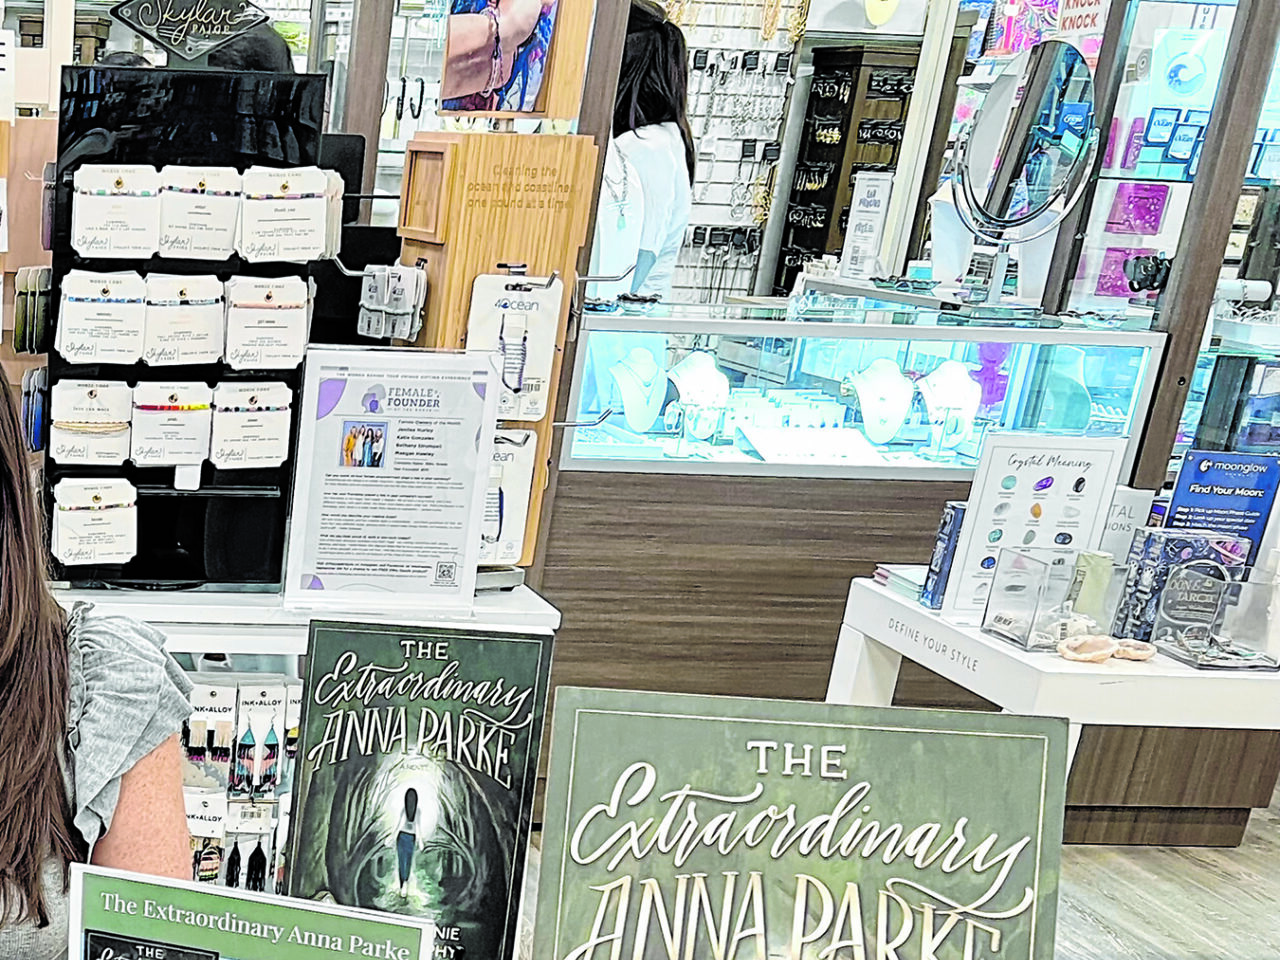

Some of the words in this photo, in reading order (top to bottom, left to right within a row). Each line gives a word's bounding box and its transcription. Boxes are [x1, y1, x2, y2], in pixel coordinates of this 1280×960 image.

[1061, 13, 1098, 31] KNOCK
[542, 166, 556, 176] the
[388, 388, 433, 398] FEMALE
[388, 398, 440, 408] FOUNDER
[1008, 453, 1044, 471] Crystal
[1046, 455, 1093, 472] Meaning
[1214, 462, 1268, 474] moonglow
[1190, 484, 1211, 494] Find
[1212, 486, 1234, 495] Your
[400, 639, 450, 661] THE
[888, 618, 920, 642] DEFINE
[923, 636, 948, 656] YOUR
[950, 649, 978, 672] STYLE
[313, 651, 534, 731] Extraordinary
[307, 705, 408, 772] ANNA
[417, 707, 517, 790] PARKE
[746, 740, 849, 780] THE
[569, 761, 1033, 919] Extraordinary
[100, 892, 138, 915] The
[143, 900, 284, 944] Extraordinary
[286, 926, 343, 952] Anna
[136, 946, 164, 959] THE
